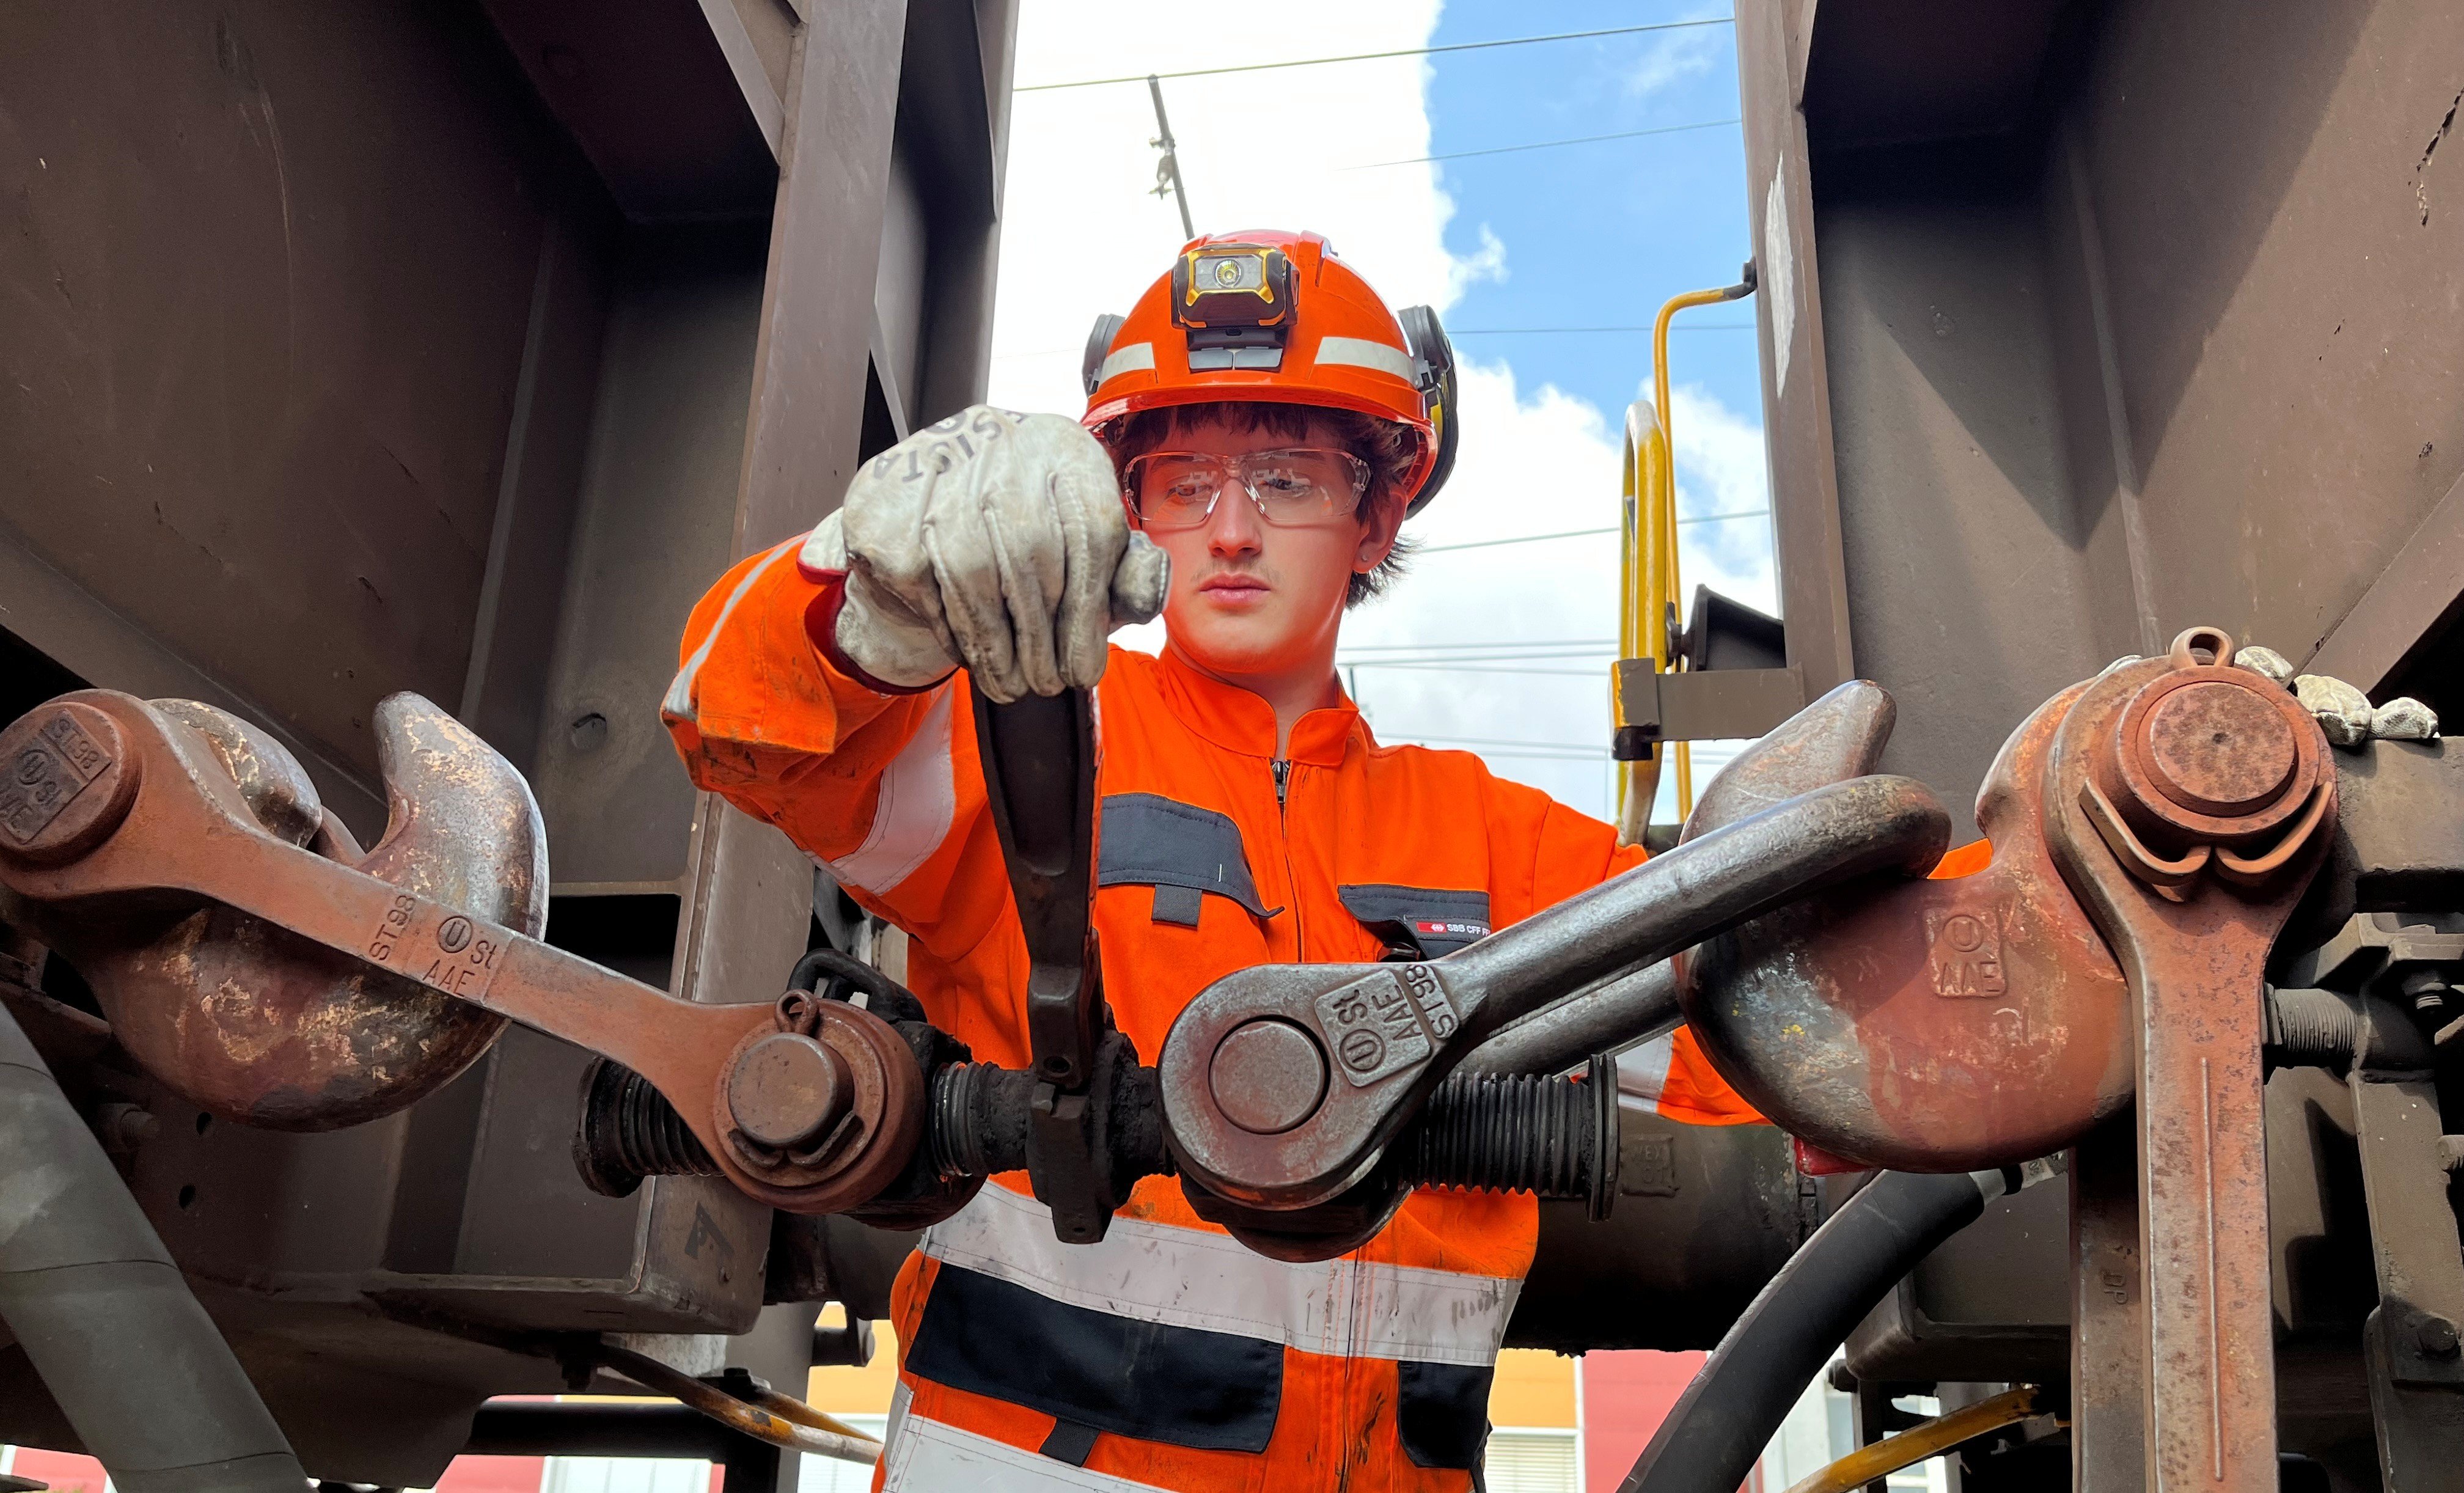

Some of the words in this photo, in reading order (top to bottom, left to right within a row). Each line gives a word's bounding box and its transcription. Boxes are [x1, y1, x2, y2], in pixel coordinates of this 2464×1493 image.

[369, 895, 416, 960] ST98
[1447, 923, 1465, 933] SBB
[1466, 925, 1481, 934] CFF
[471, 940, 497, 970] St
[422, 959, 475, 997] AAE
[1941, 961, 2000, 993] AAE
[1333, 989, 1368, 1024] St
[1371, 985, 1422, 1040] AAE
